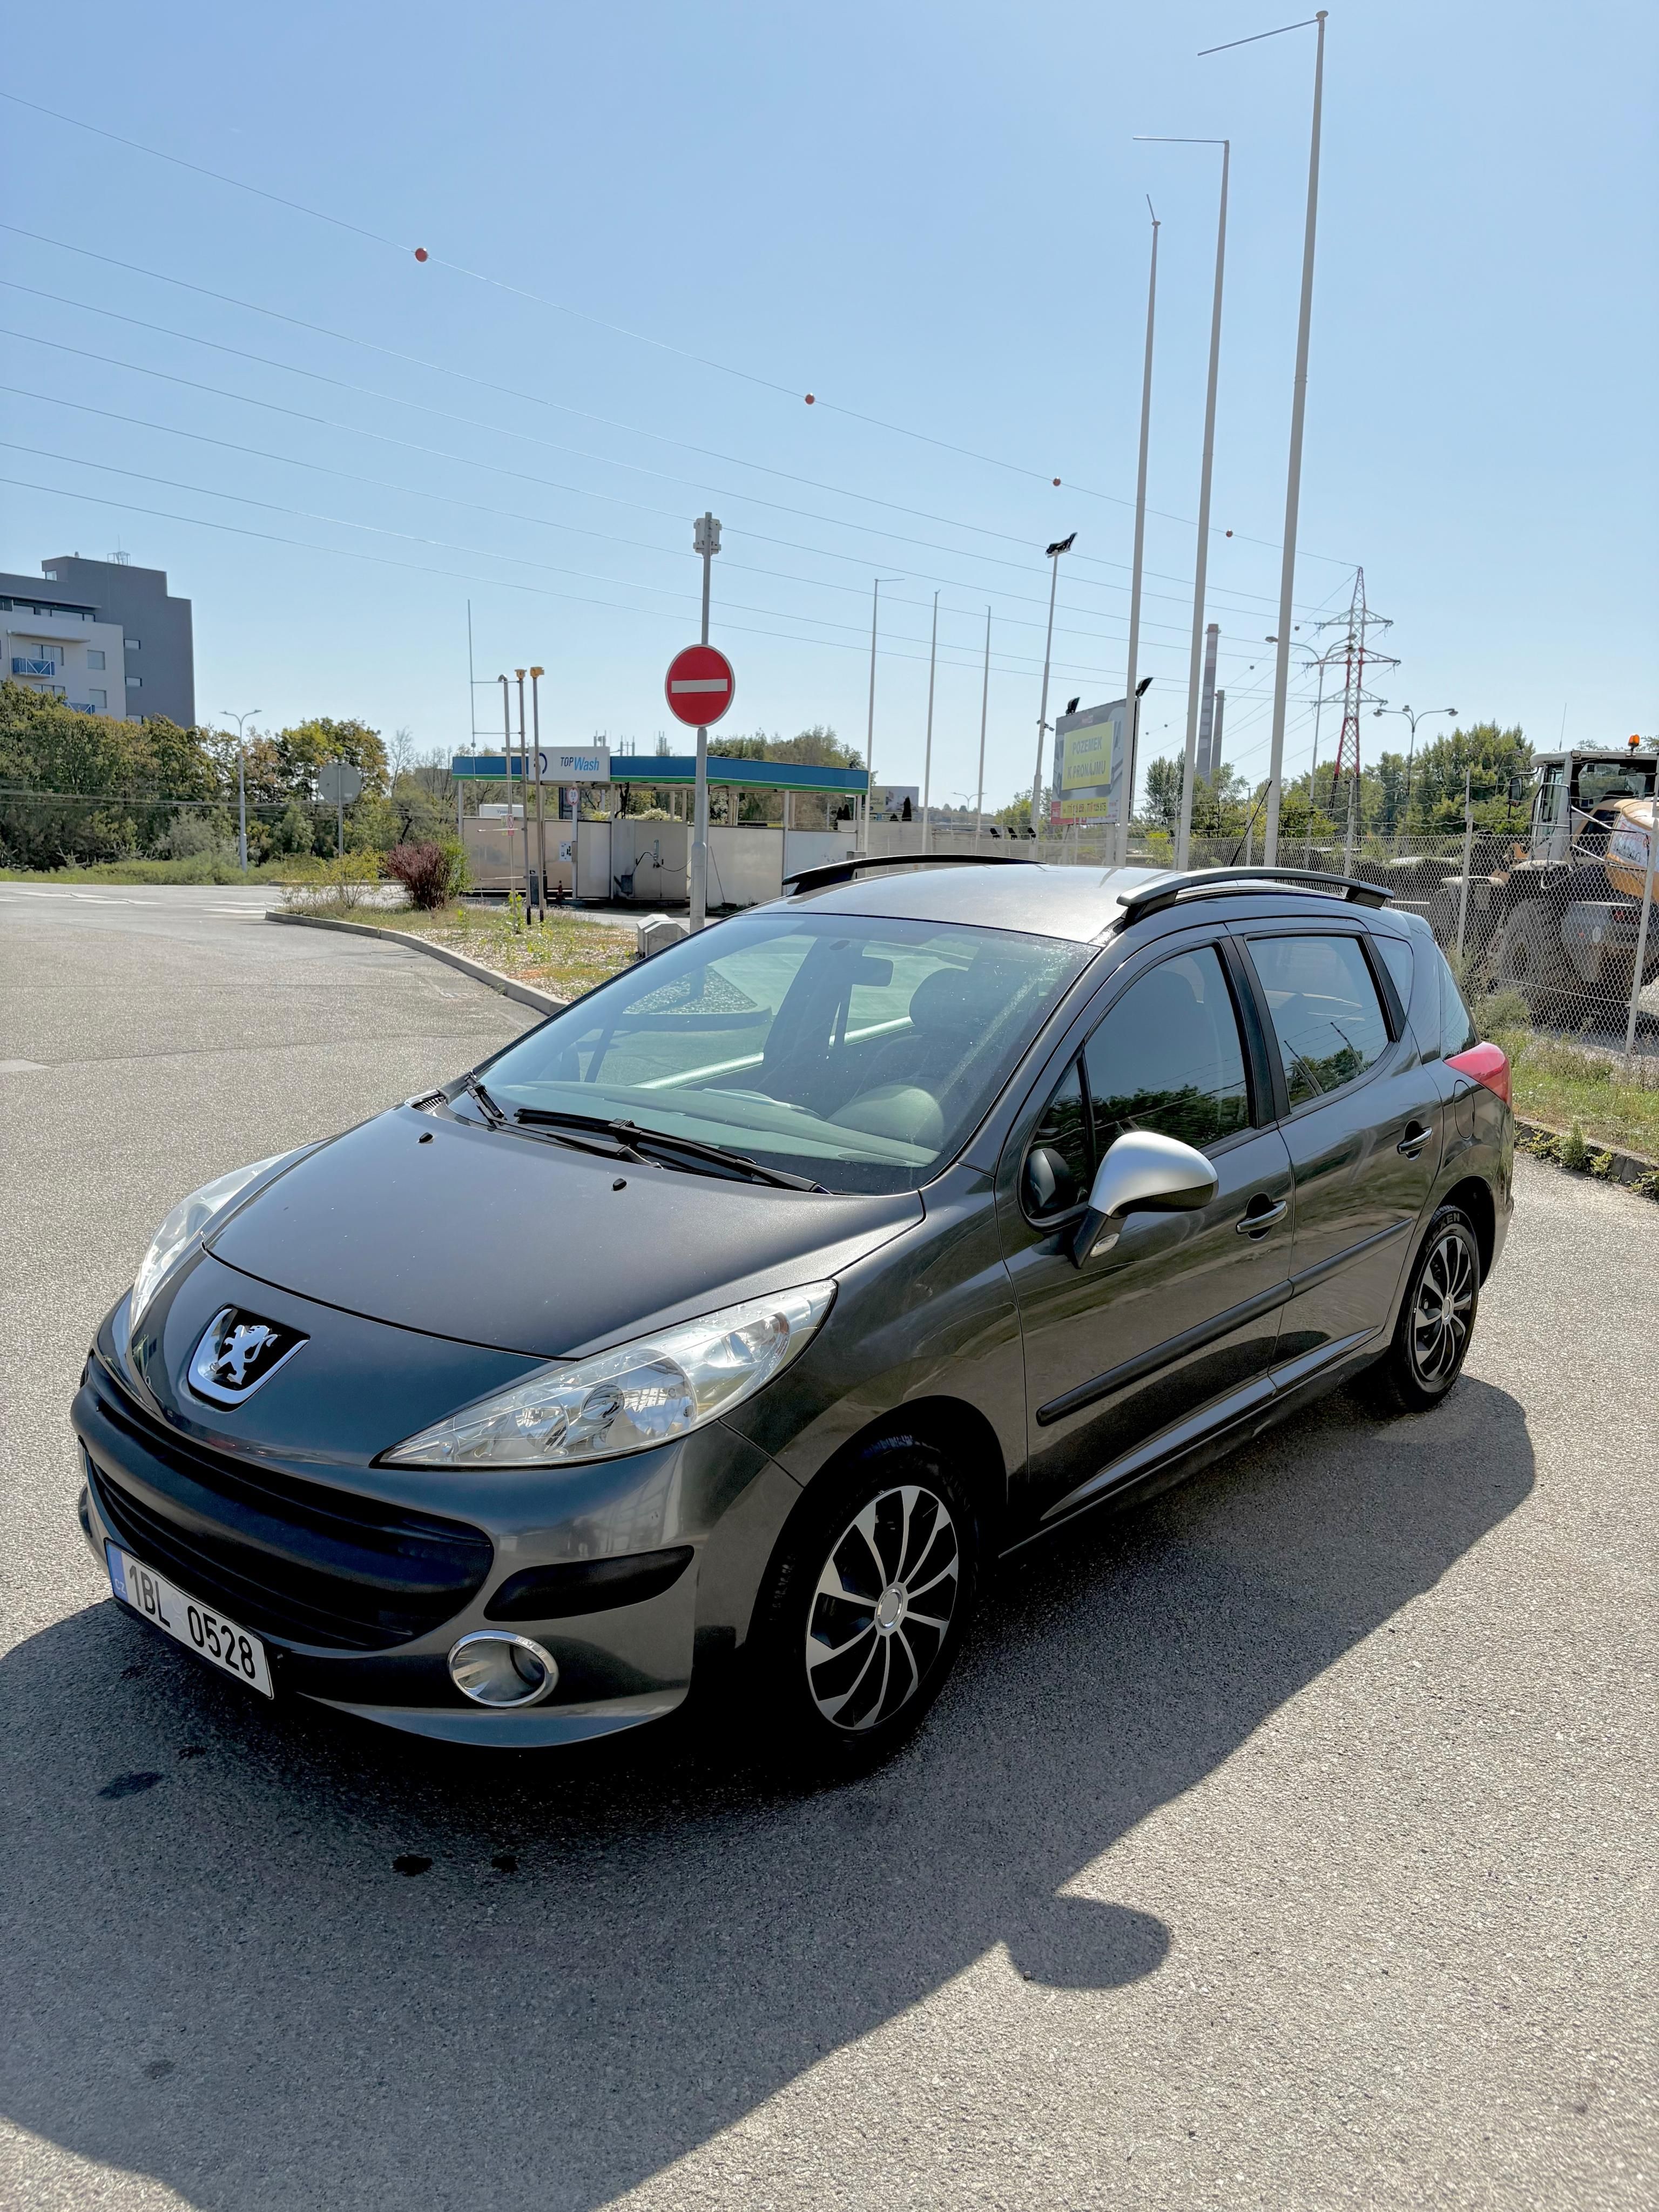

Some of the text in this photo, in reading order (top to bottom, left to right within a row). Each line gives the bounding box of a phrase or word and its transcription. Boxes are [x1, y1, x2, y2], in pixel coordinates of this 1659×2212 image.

[1072, 736, 1102, 756] POZEMEK
[1067, 760, 1106, 779] K PRONÁJMU
[115, 1578, 126, 1594] CZ
[129, 1565, 255, 1680] 1BL 0528
